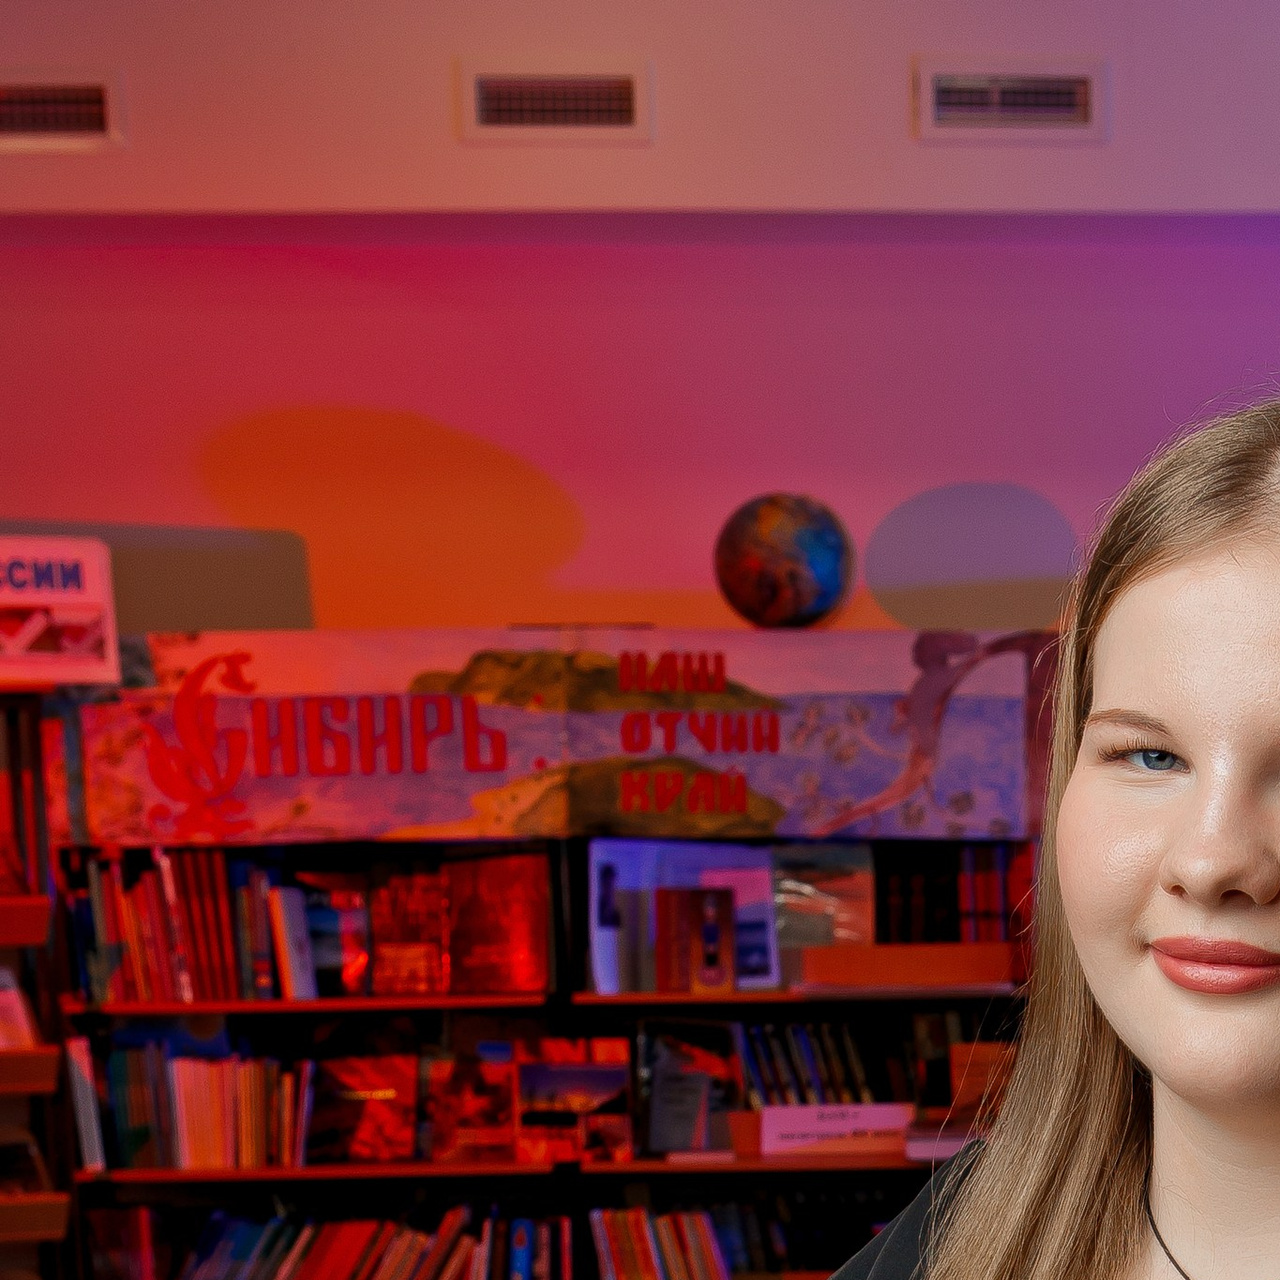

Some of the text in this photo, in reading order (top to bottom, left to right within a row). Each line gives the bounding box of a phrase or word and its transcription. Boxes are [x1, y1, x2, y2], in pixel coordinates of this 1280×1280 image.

[0, 560, 83, 590] СИИ
[618, 651, 727, 694] НАШ
[619, 766, 748, 814] КРАЙ
